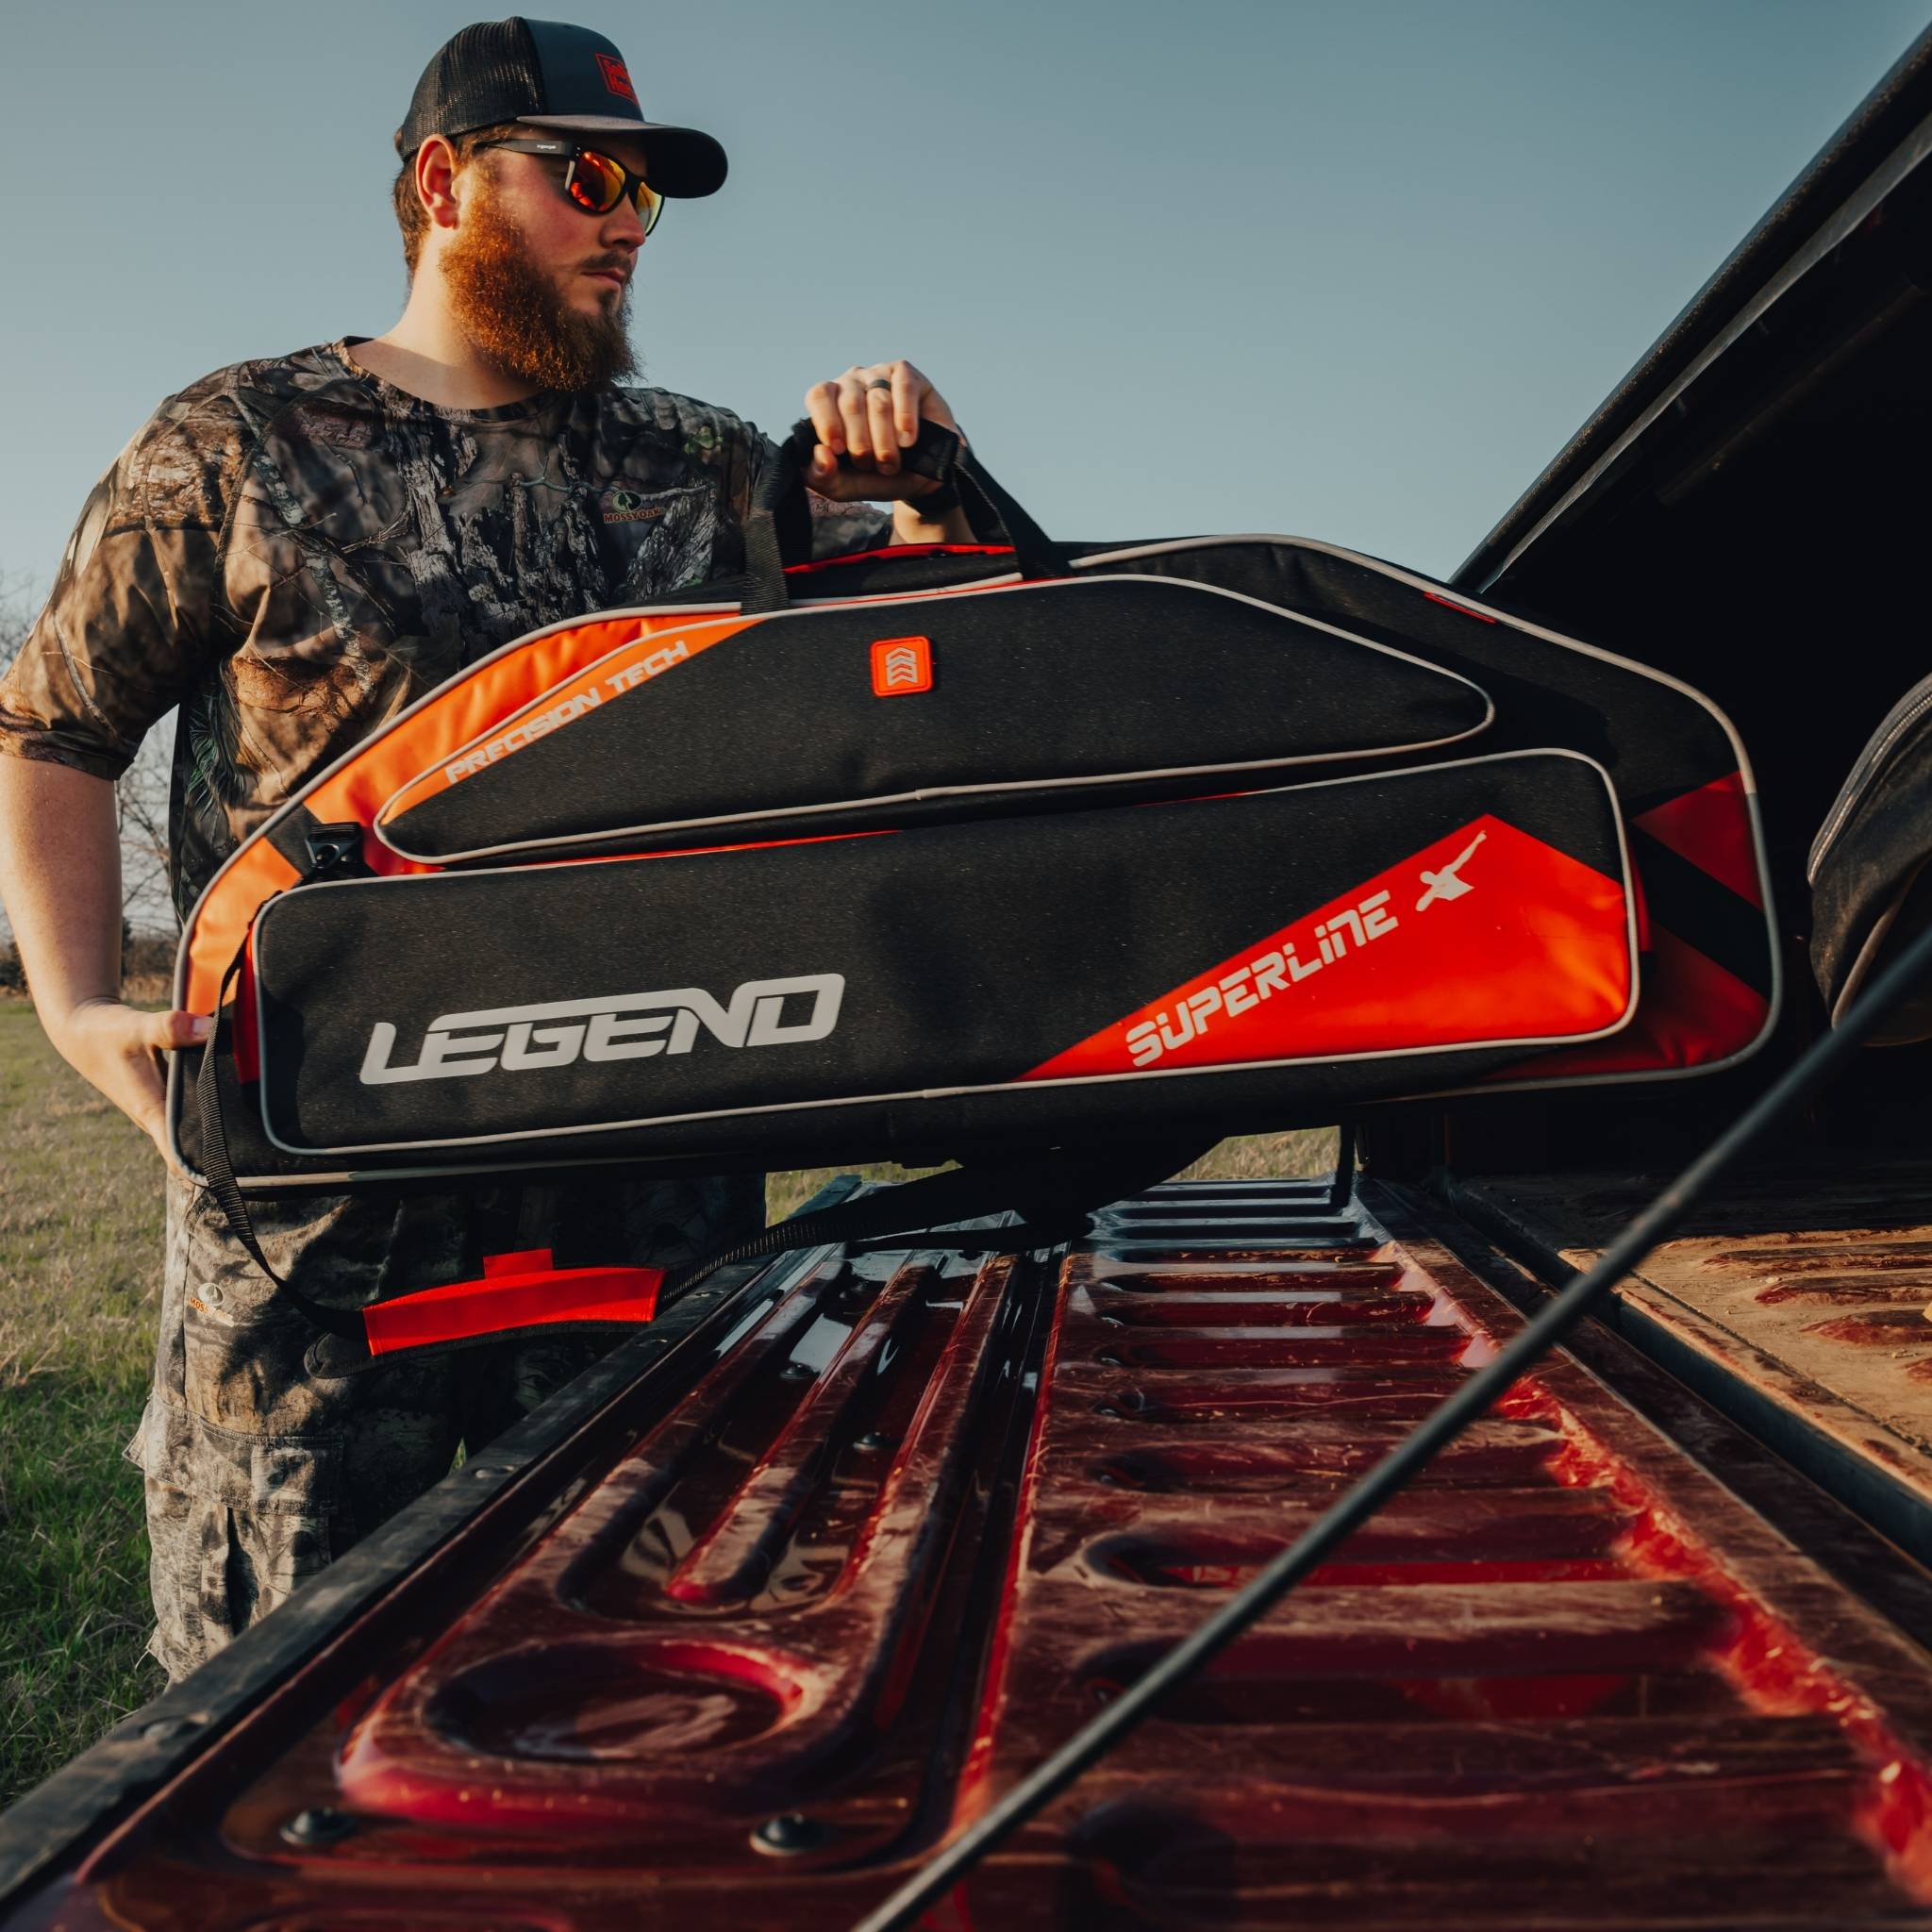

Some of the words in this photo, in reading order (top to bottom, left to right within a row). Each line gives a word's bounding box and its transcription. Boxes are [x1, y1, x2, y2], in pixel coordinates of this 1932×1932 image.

[604, 512, 639, 524] MOSSY
[639, 508, 661, 520] OAK
[445, 687, 603, 784] PRECISION
[606, 640, 691, 692] TECH
[359, 973, 846, 1085] LEGEND
[1125, 890, 1399, 1067] SUPERLINE
